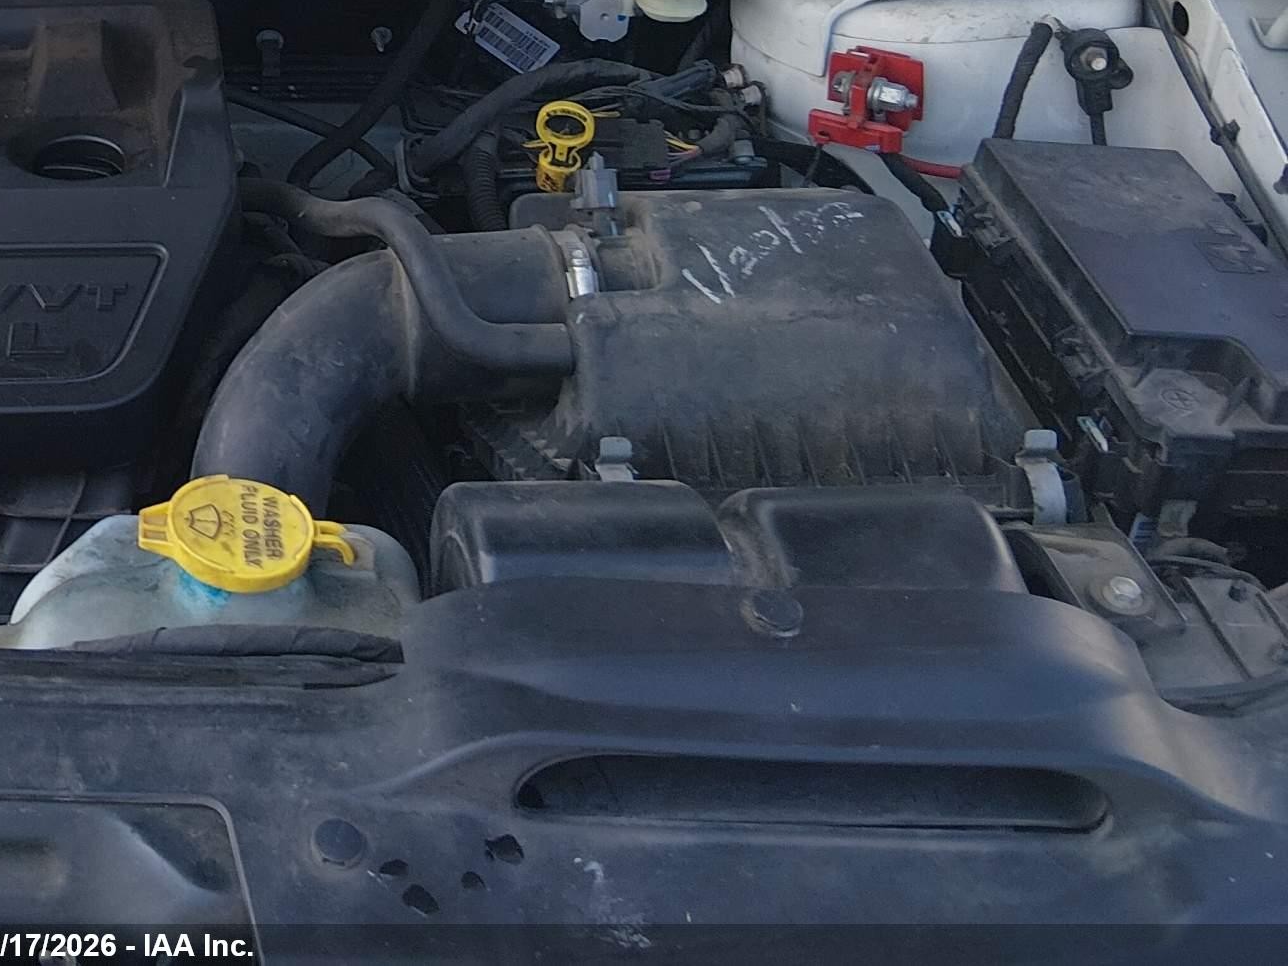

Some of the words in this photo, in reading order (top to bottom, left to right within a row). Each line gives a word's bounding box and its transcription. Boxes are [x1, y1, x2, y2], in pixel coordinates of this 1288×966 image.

[242, 485, 258, 524] FLUID
[263, 498, 283, 559] WASHER
[243, 530, 263, 569] ONLY
